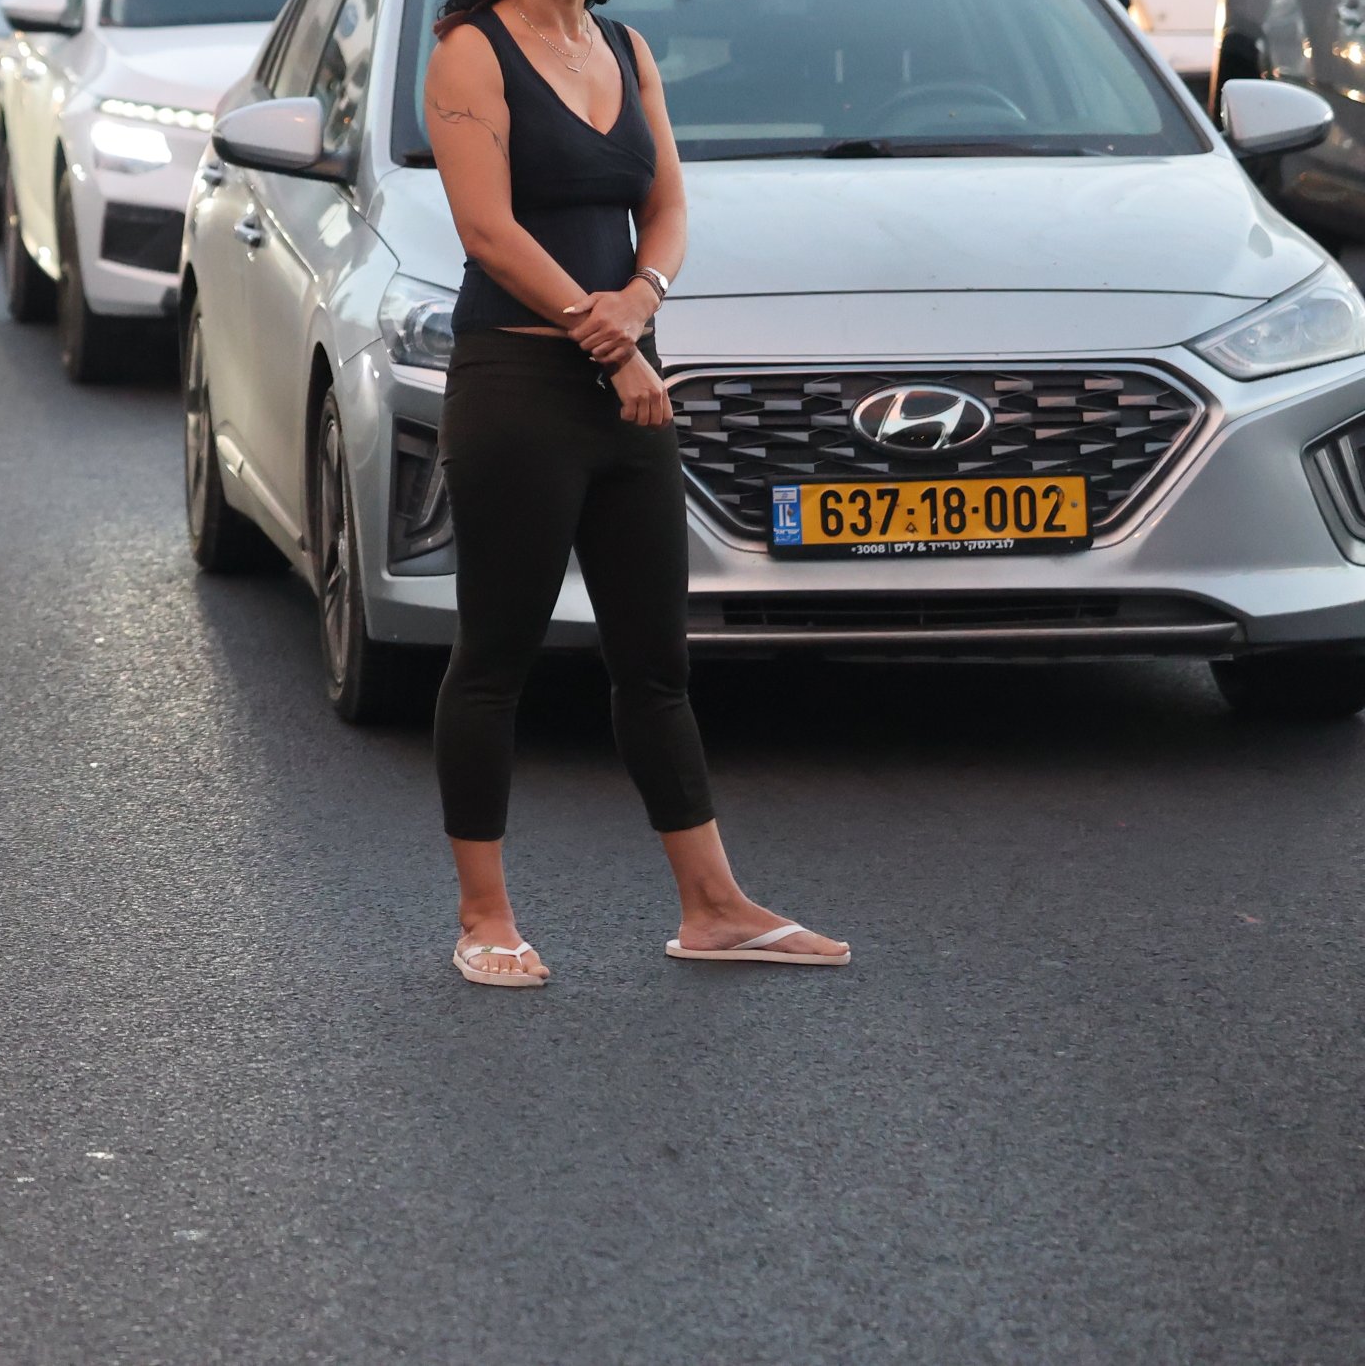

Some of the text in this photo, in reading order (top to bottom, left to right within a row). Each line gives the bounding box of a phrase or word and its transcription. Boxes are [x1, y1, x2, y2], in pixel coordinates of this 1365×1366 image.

[778, 503, 797, 527] IL
[917, 541, 927, 551] &
[963, 538, 1015, 552] לובינסקי
